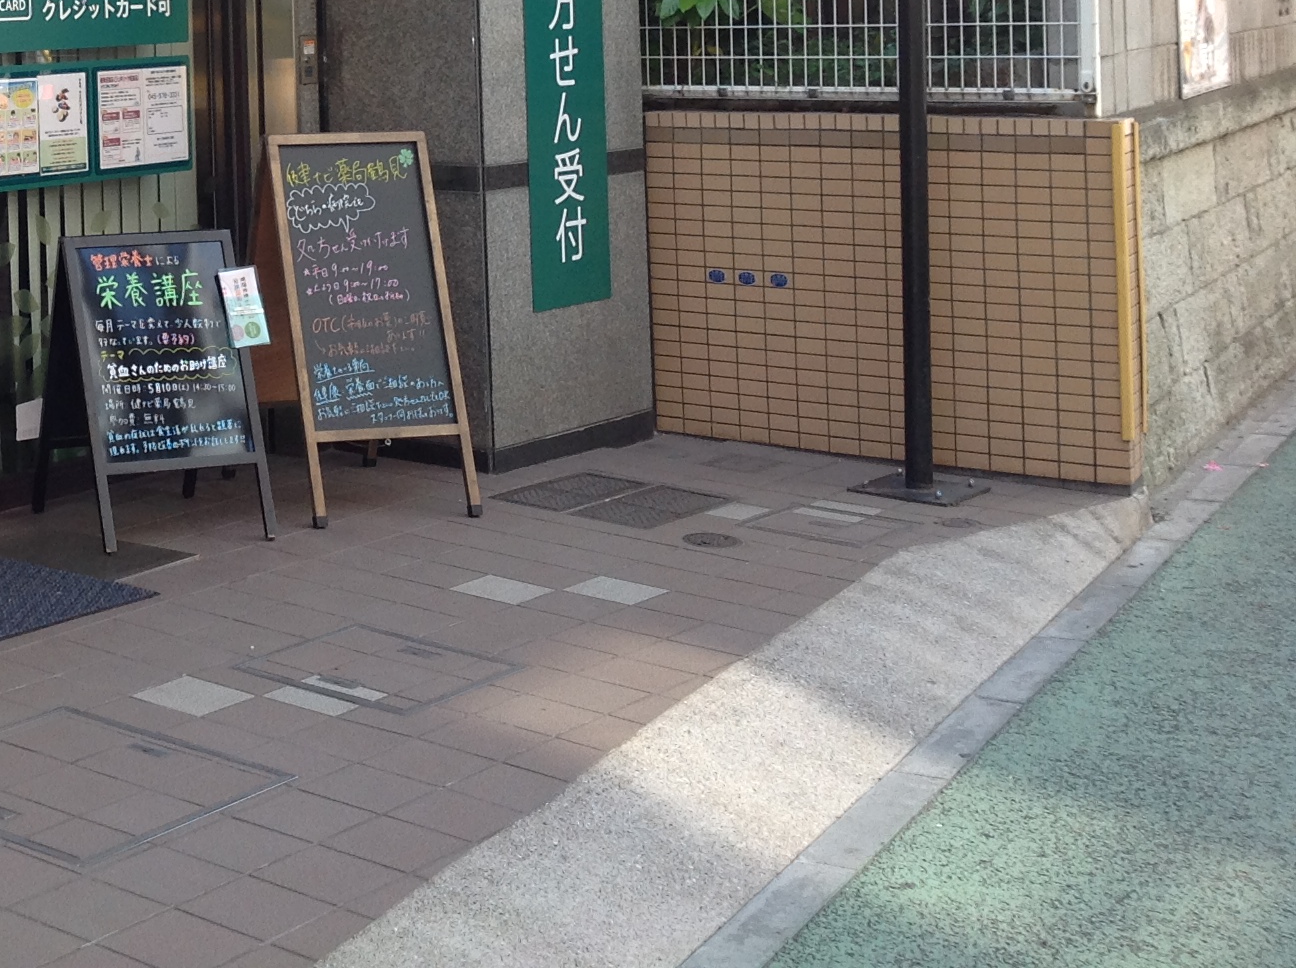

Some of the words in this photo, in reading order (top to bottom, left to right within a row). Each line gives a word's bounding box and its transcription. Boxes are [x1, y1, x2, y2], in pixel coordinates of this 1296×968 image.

[95, 268, 204, 310] 栄養講座
[100, 349, 126, 363] テーマ
